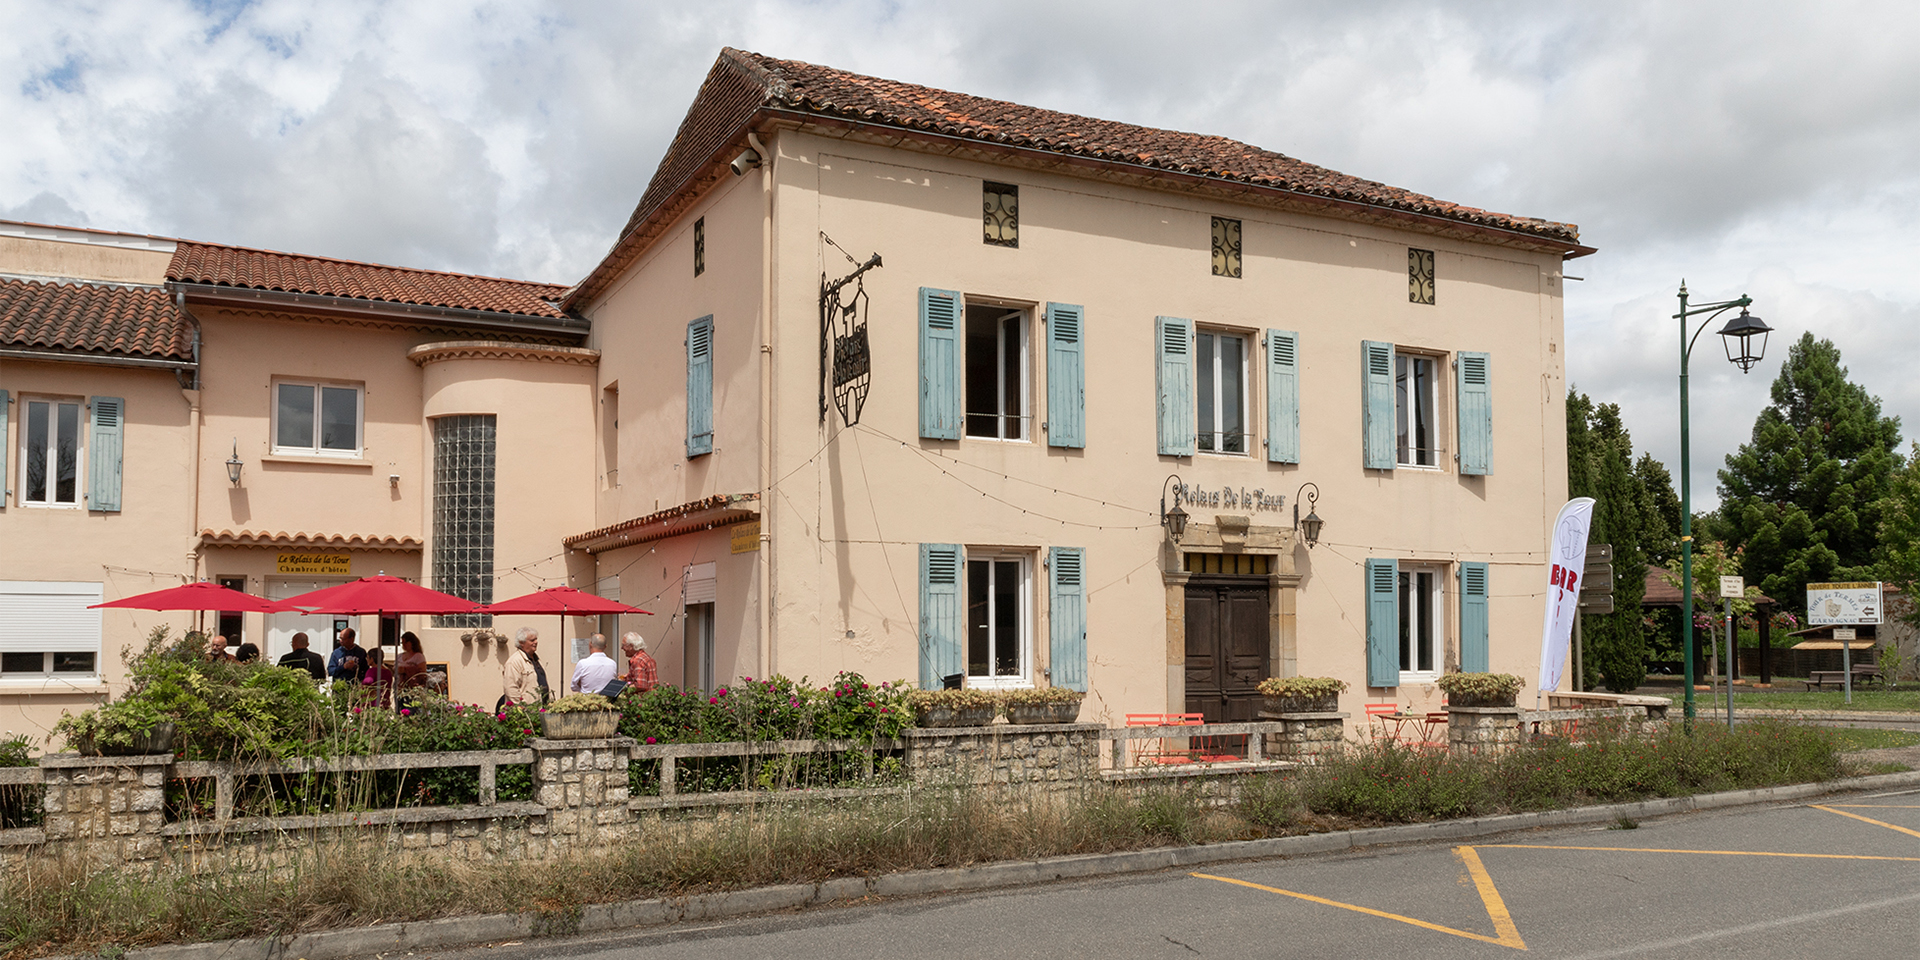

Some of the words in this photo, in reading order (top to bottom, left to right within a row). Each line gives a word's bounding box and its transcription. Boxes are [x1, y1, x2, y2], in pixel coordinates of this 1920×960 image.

[1241, 486, 1253, 505] la
[277, 555, 288, 563] Le
[289, 555, 312, 565] Relais
[314, 555, 322, 564] de
[323, 555, 331, 564] la
[332, 555, 349, 564] Tour
[279, 565, 317, 573] Chambres
[1550, 564, 1577, 592] BAR
